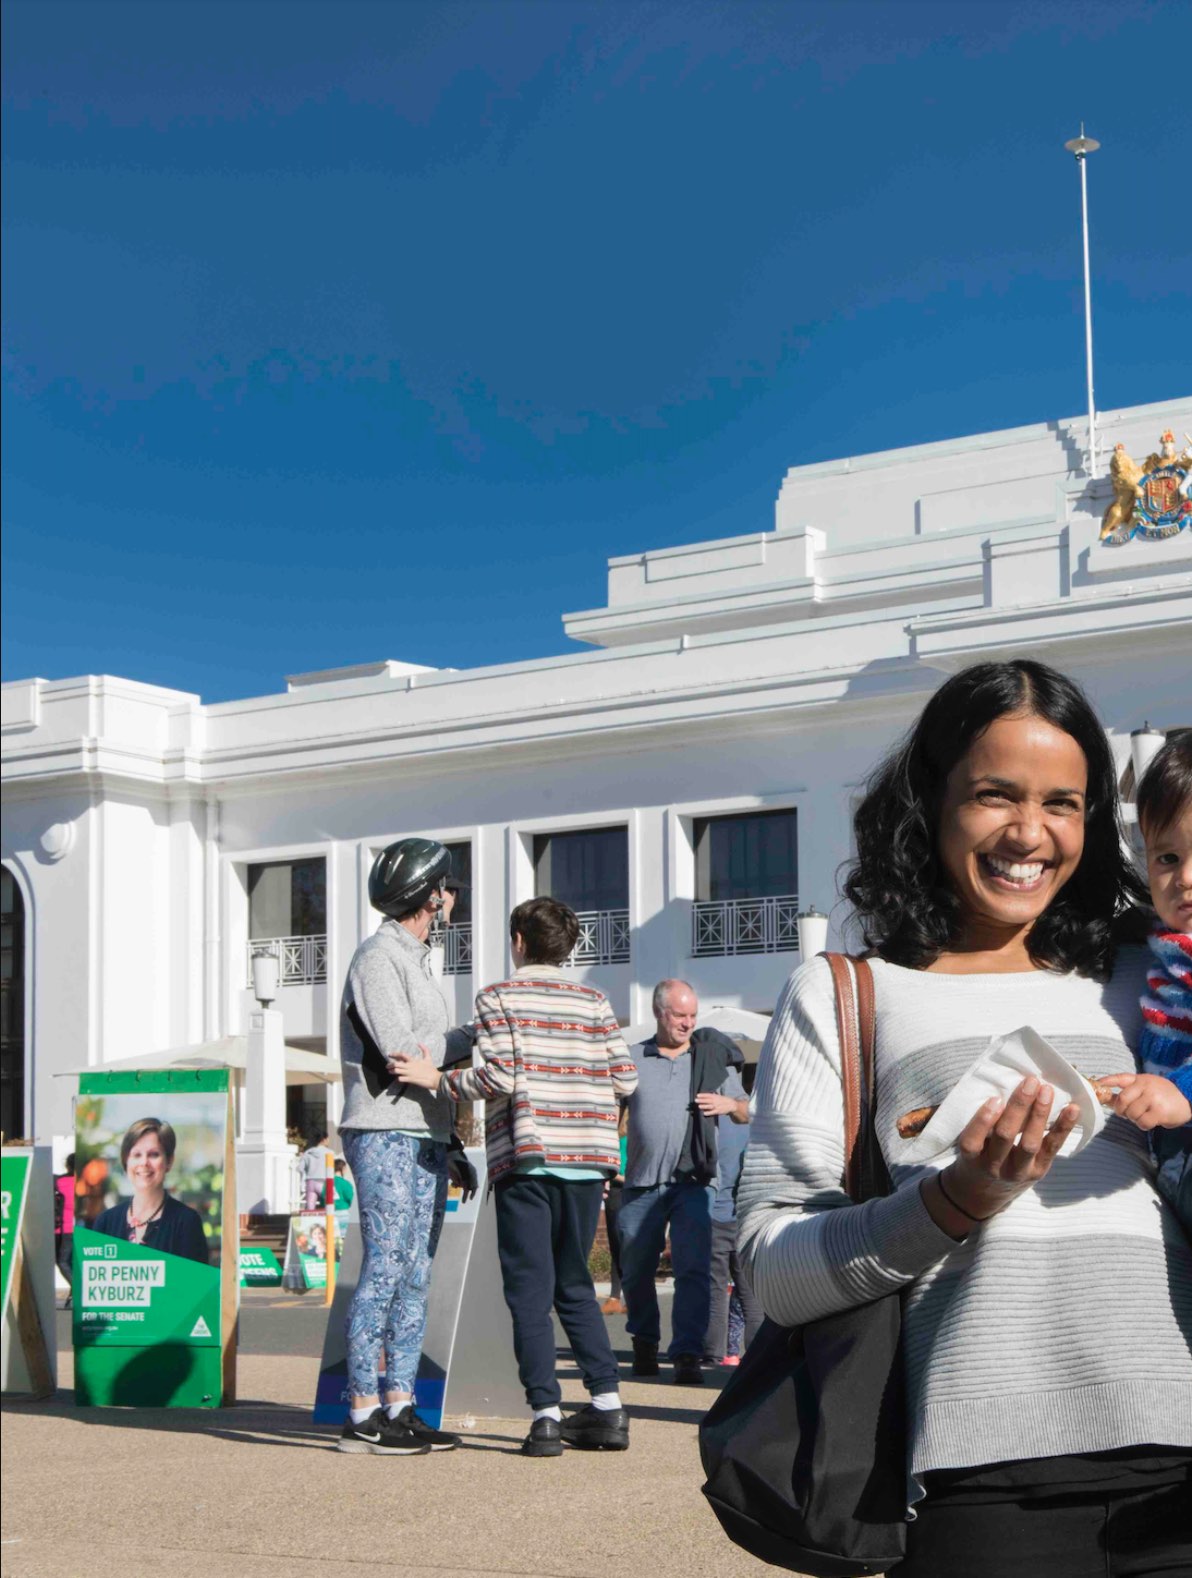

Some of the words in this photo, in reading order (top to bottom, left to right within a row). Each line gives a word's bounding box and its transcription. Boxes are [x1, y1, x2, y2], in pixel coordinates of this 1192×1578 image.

[83, 1246, 103, 1256] VOTE
[88, 1266, 107, 1281] DR
[111, 1266, 160, 1281] PENNY
[88, 1286, 145, 1301] KYBURZ
[82, 1311, 98, 1321] FOR
[98, 1311, 115, 1321] THE
[115, 1311, 145, 1321] SENATE
